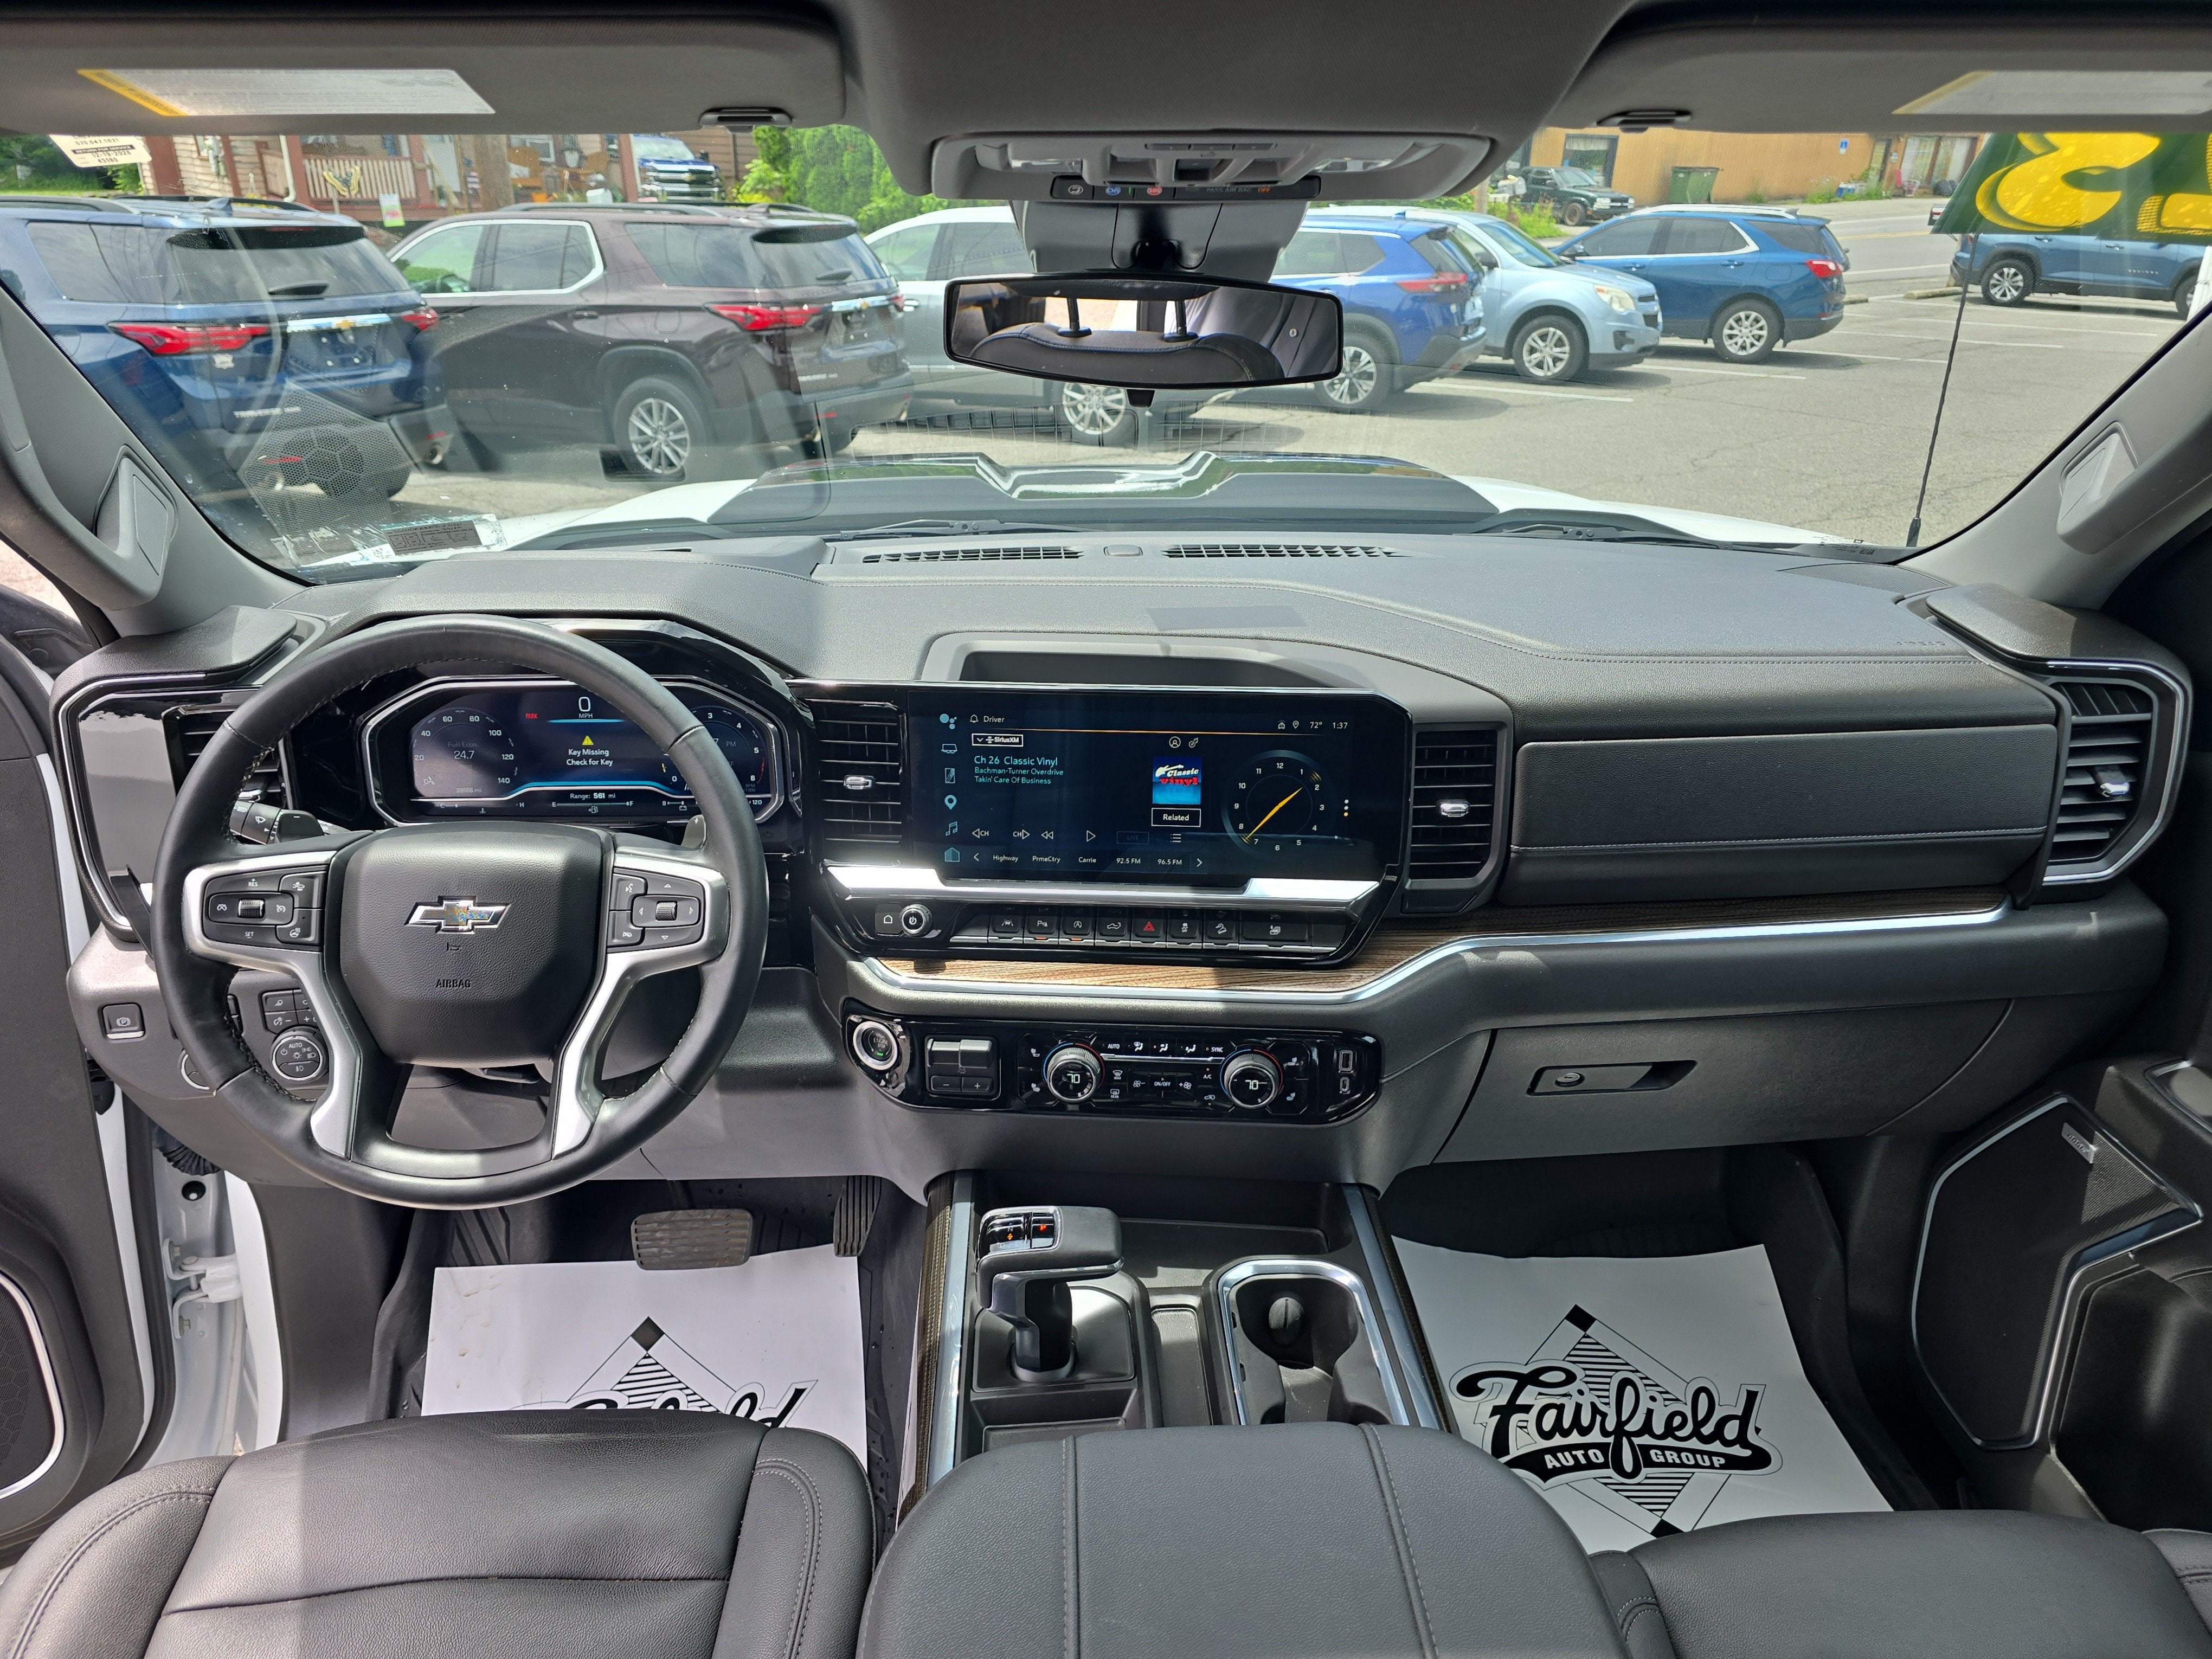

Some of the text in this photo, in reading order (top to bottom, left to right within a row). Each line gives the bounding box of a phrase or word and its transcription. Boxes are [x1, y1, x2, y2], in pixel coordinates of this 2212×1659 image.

[578, 697, 591, 712] 0
[454, 750, 475, 760] 24.7
[568, 749, 609, 757] Key Missing
[974, 755, 986, 764] Ch
[1004, 756, 1035, 765] Classic
[1037, 757, 1057, 768] Vinyl
[974, 767, 1029, 775] Bachman-Turner
[1167, 768, 1199, 777] Classic
[993, 854, 1018, 863] Highway
[435, 979, 471, 988] AIRBAG
[1067, 1073, 1080, 1083] 70
[1245, 1080, 1258, 1090] 70
[1456, 1365, 1772, 1479] Fairfield
[1544, 1448, 1726, 1470] AUTO GROUP
